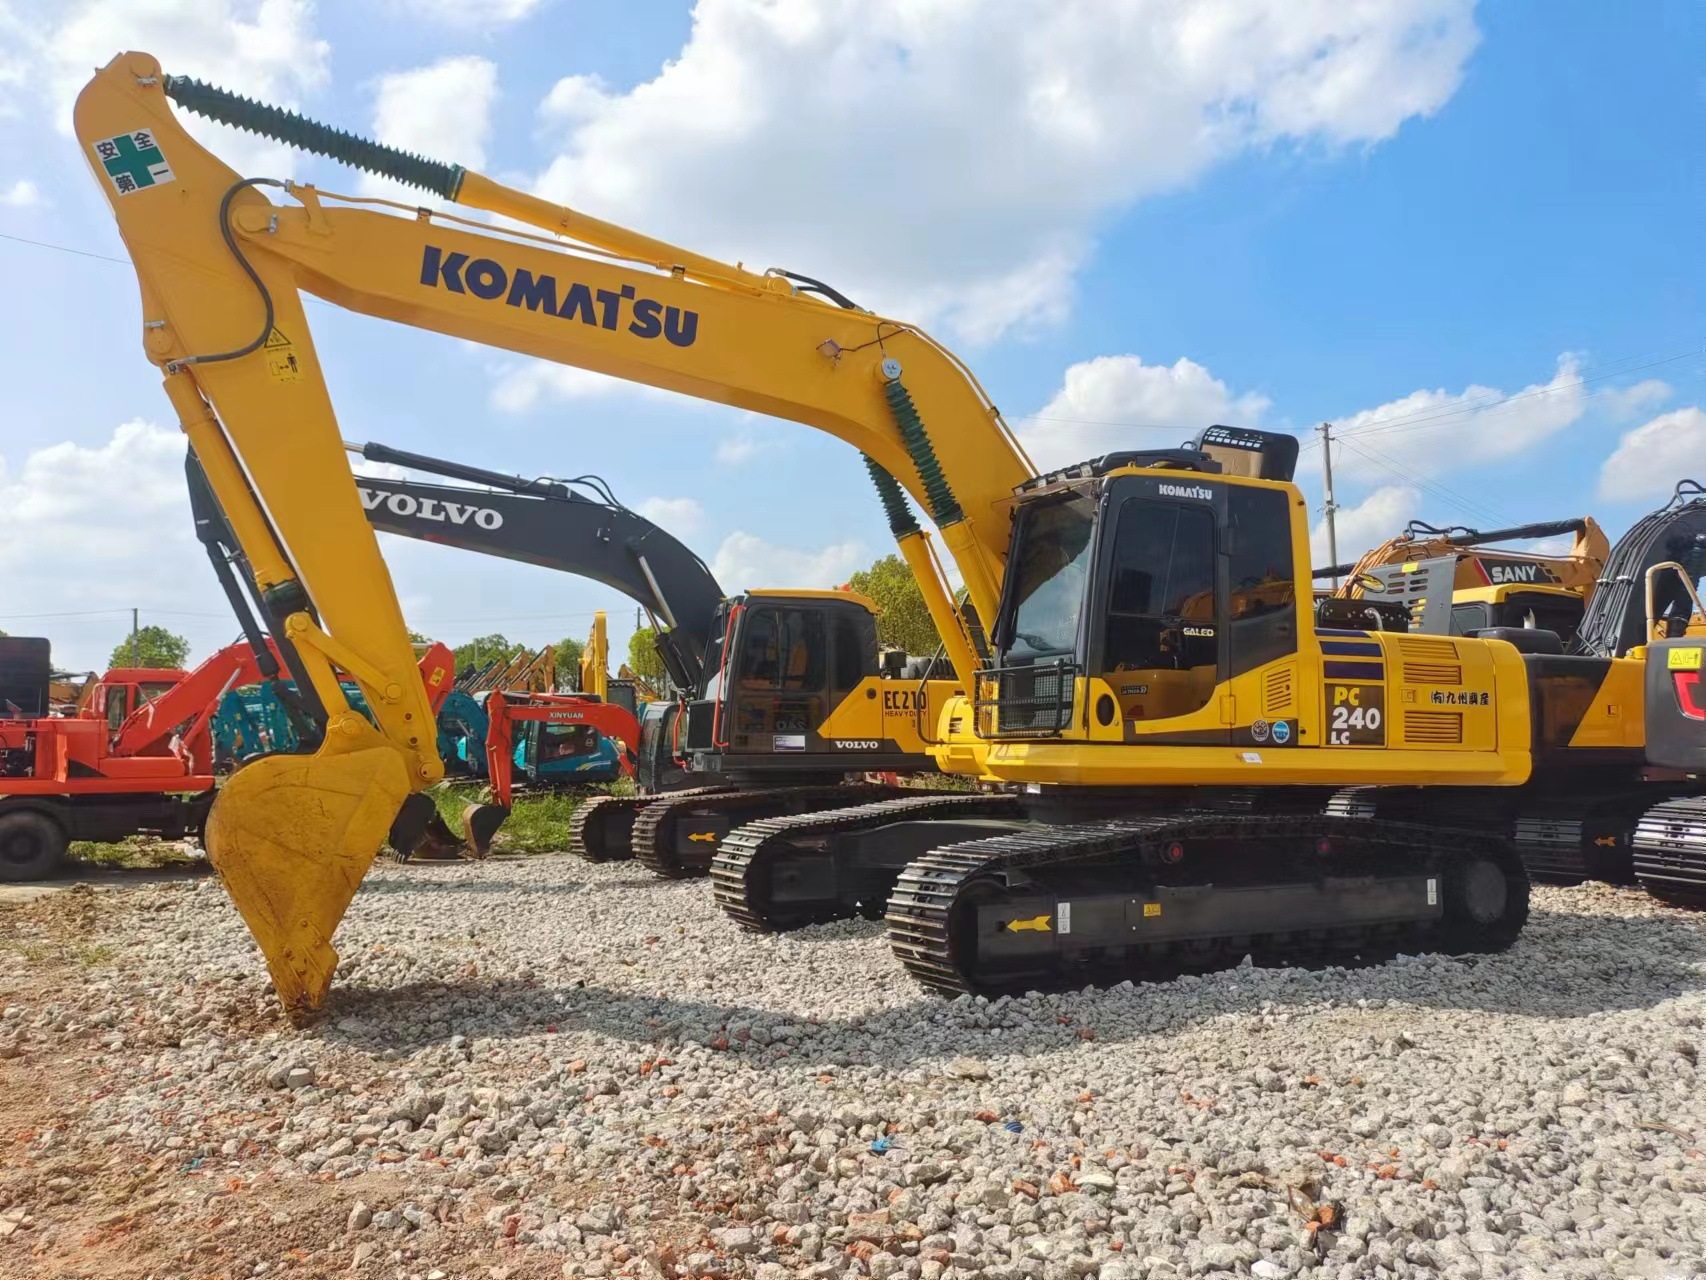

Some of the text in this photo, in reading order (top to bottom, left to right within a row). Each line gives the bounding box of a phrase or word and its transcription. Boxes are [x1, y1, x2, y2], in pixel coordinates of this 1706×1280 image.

[420, 244, 699, 347] KOMATSU
[1158, 483, 1213, 500] KOMATSU
[357, 487, 504, 530] VOLVO
[1491, 565, 1537, 583] SANY
[1182, 627, 1214, 637] GALEO
[1333, 686, 1360, 706] PC
[549, 711, 584, 719] XINYUAN
[1331, 706, 1381, 730] 240
[834, 740, 879, 749] VOLVO
[1330, 731, 1351, 745] LC
